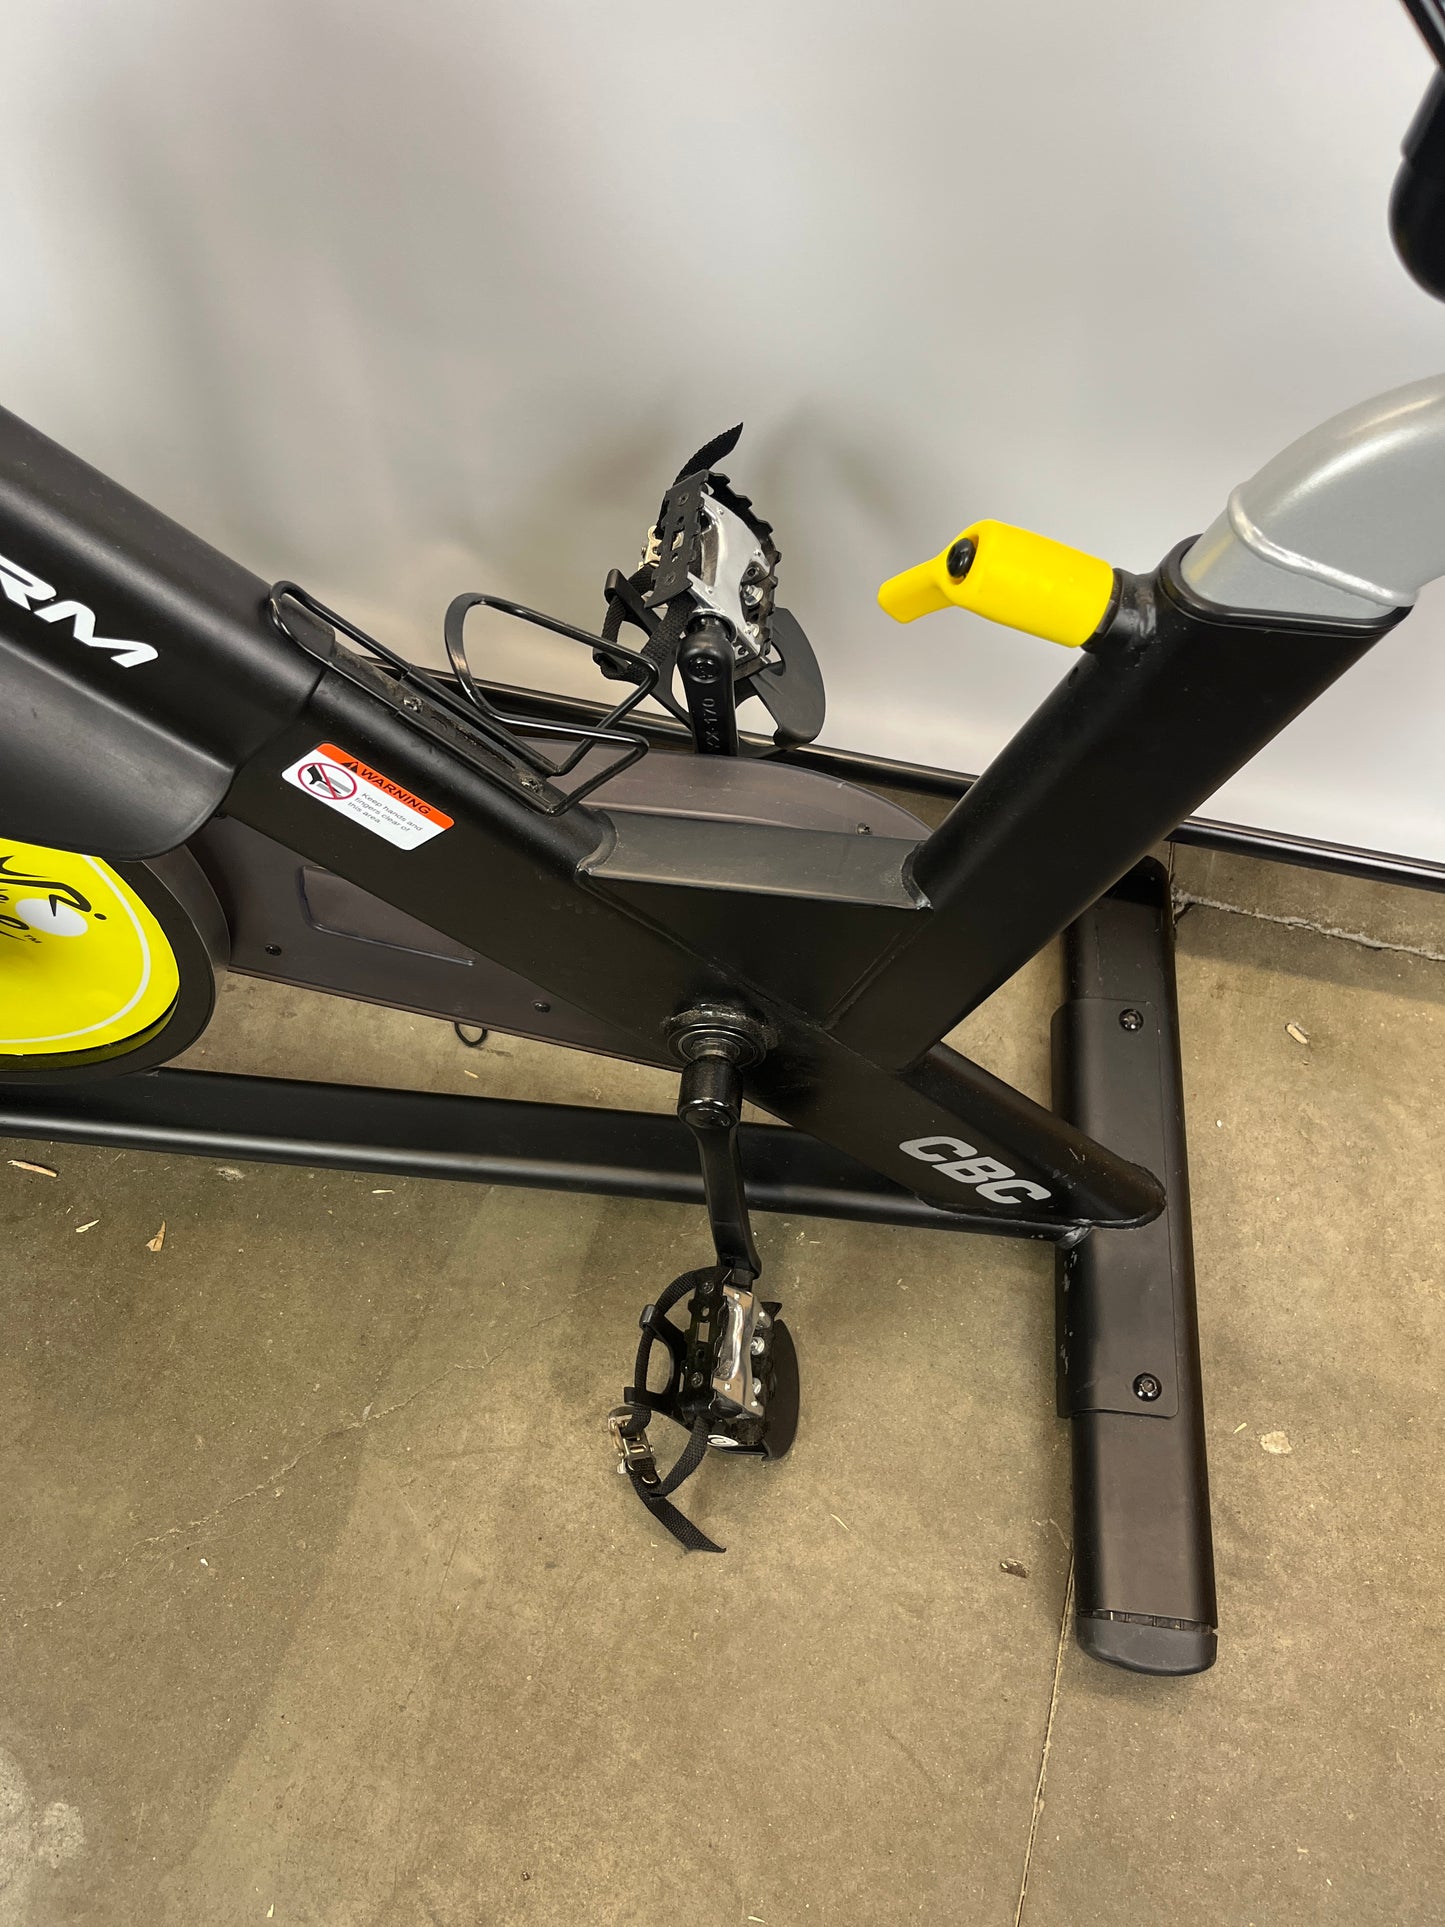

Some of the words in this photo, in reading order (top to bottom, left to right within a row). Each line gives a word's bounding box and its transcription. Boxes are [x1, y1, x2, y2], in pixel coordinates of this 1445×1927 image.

[347, 801, 362, 813] this
[361, 768, 431, 815] WARNING
[354, 797, 380, 815] fingers
[381, 812, 401, 826] clear
[400, 825, 412, 833] of
[361, 792, 383, 807] Keep
[383, 805, 407, 822] hands
[406, 818, 424, 832] and
[899, 1135, 1053, 1205] CBC
